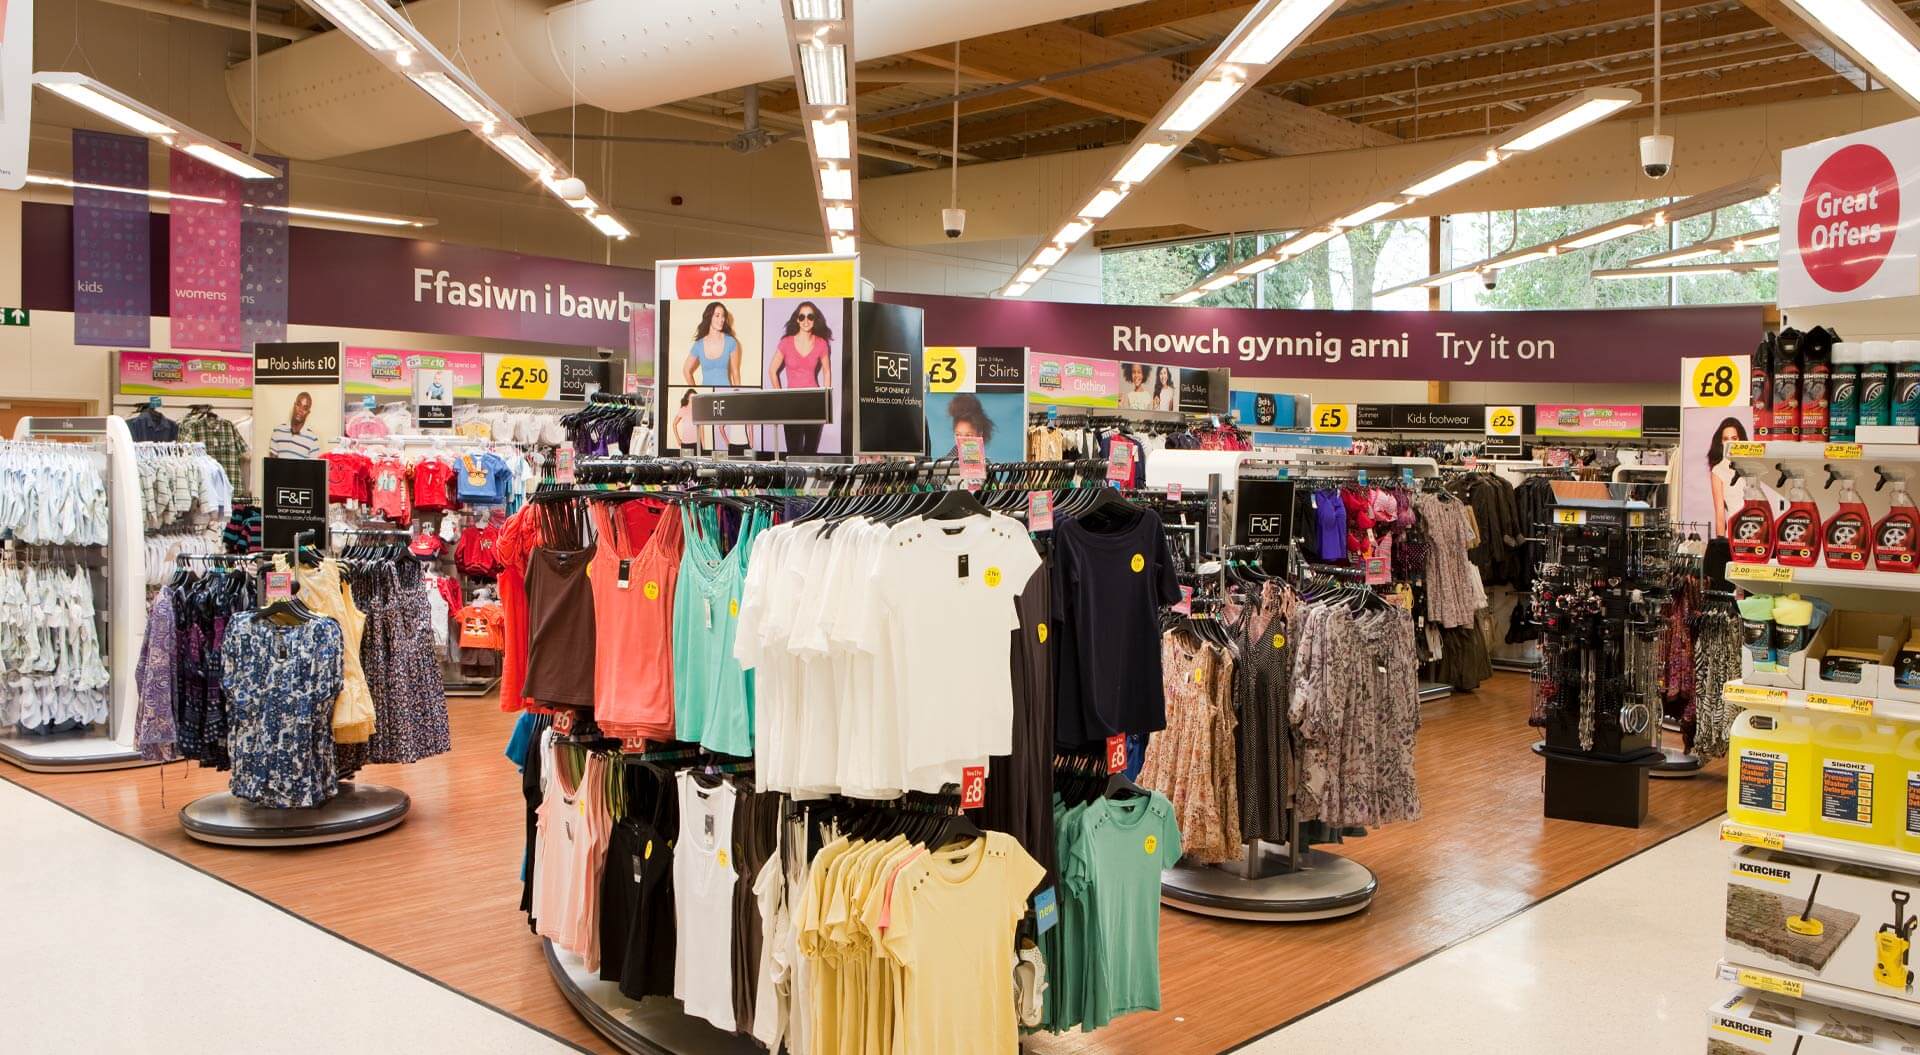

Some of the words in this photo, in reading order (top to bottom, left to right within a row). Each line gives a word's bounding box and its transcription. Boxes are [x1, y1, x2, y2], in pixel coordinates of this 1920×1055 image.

[1816, 187, 1880, 218] Great
[1811, 222, 1882, 252] Offers
[776, 266, 801, 280] Tops
[804, 266, 812, 278] &
[77, 280, 104, 294] kids
[702, 271, 728, 297] £8
[776, 279, 826, 292] Leggings
[175, 287, 227, 301] womens
[414, 268, 537, 314] Ffasiwn
[544, 283, 552, 314] i
[559, 285, 632, 322] bawb
[1112, 326, 1230, 354] Rhowch
[1238, 331, 1342, 363] gynnig
[1350, 332, 1409, 359] arni
[1436, 332, 1482, 365] Try
[1489, 333, 1514, 359] it
[1518, 338, 1556, 360] on
[127, 361, 148, 371] F&F
[212, 361, 226, 371] £10
[269, 356, 291, 371] Polo
[292, 357, 315, 371] shirts
[317, 356, 336, 370] £10
[430, 359, 445, 368] £10
[877, 356, 909, 380] F&F
[929, 357, 957, 384] £3
[977, 363, 986, 377] T
[988, 363, 1020, 377] Shirts
[499, 366, 549, 390] £2.50
[562, 364, 570, 376] 3
[572, 367, 594, 379] pack
[200, 373, 245, 386] Clothing
[1073, 378, 1106, 393] Clothing
[1699, 366, 1733, 397] £8
[1319, 409, 1341, 428] £5
[1407, 413, 1427, 424] Kids
[1429, 412, 1470, 425] footwear
[1492, 415, 1515, 427] £25
[1592, 418, 1627, 428] Clothing
[1487, 437, 1504, 445] Macs
[278, 490, 311, 505] F&F
[264, 514, 327, 523] www.tesco.com/clothing
[1563, 511, 1576, 522] £1
[1250, 516, 1280, 533] F&F
[1851, 704, 1869, 712] Price
[1111, 744, 1125, 769] £8
[1748, 750, 1780, 760] SIMONIZ
[1741, 768, 1765, 778] Washer
[1831, 761, 1866, 771] SIMONIZ
[1741, 774, 1772, 786] Detergent
[1823, 779, 1849, 789] Washer
[965, 777, 982, 803] £8
[1823, 786, 1857, 796] Detergent
[1039, 901, 1055, 920] new
[1783, 980, 1800, 988] SAVE
